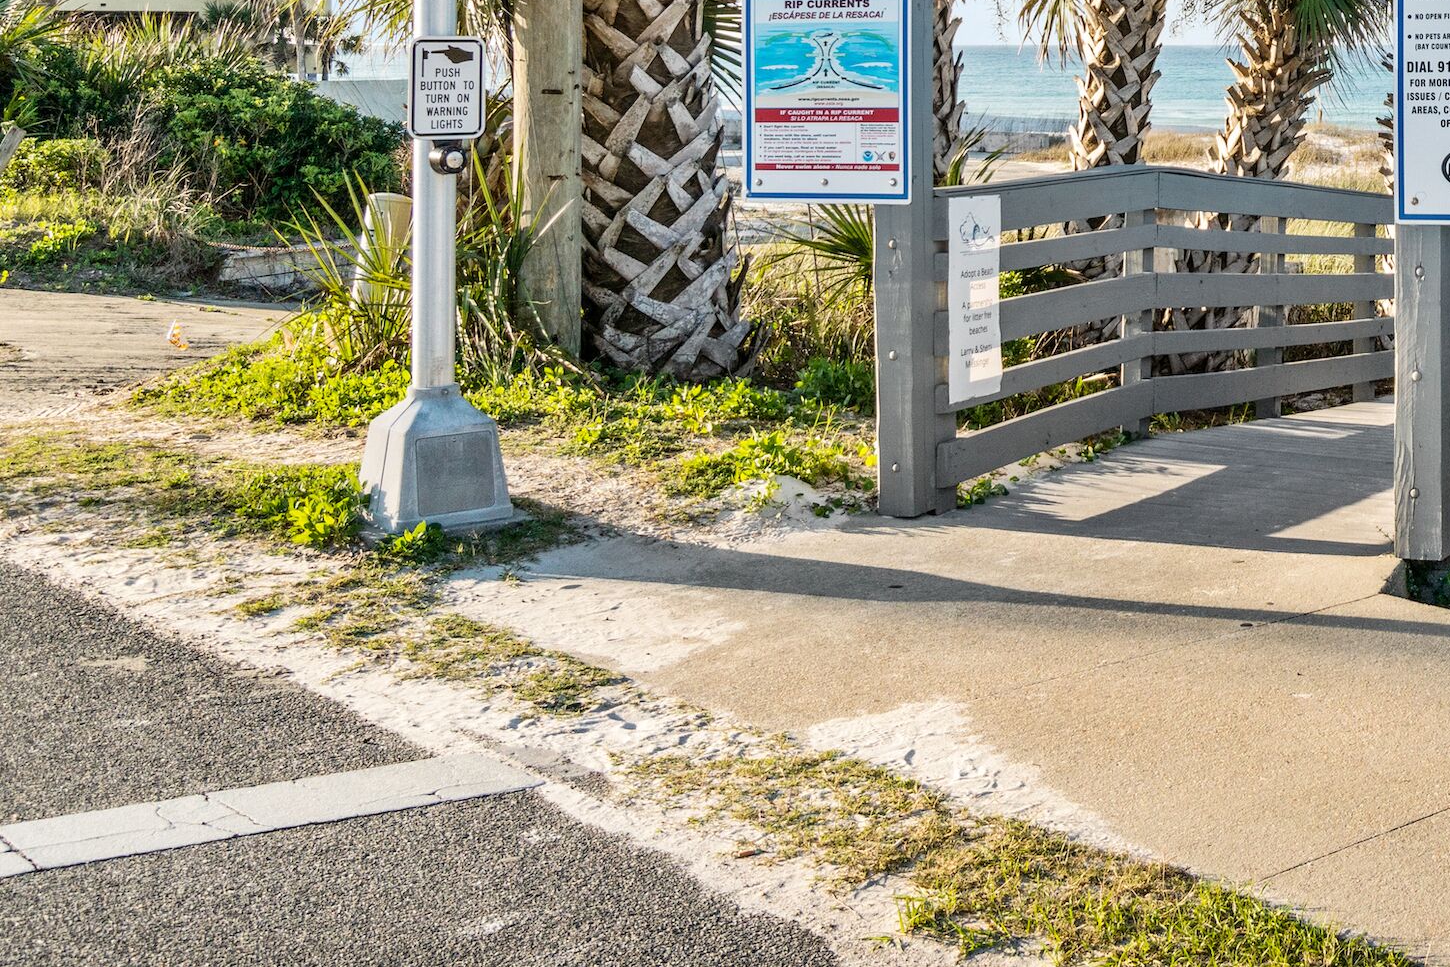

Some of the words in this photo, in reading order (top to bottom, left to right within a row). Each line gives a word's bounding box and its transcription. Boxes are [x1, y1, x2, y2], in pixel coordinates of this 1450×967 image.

[784, 0, 802, 9] RIP
[807, 0, 870, 8] CURRENTS
[818, 11, 830, 20] DE
[831, 11, 844, 19] LA
[845, 11, 884, 19] RESACA!
[1406, 61, 1433, 73] DIAL
[435, 68, 461, 77] PUSH
[420, 81, 455, 90] BUTTON
[464, 81, 474, 90] TO
[1409, 79, 1426, 87] FOR
[425, 94, 449, 103] TURN
[457, 94, 470, 102] ON
[1406, 93, 1436, 101] ISSUES
[426, 107, 468, 116] WARNING
[1411, 106, 1441, 114] AREAS,
[431, 120, 463, 129] LIGHTS
